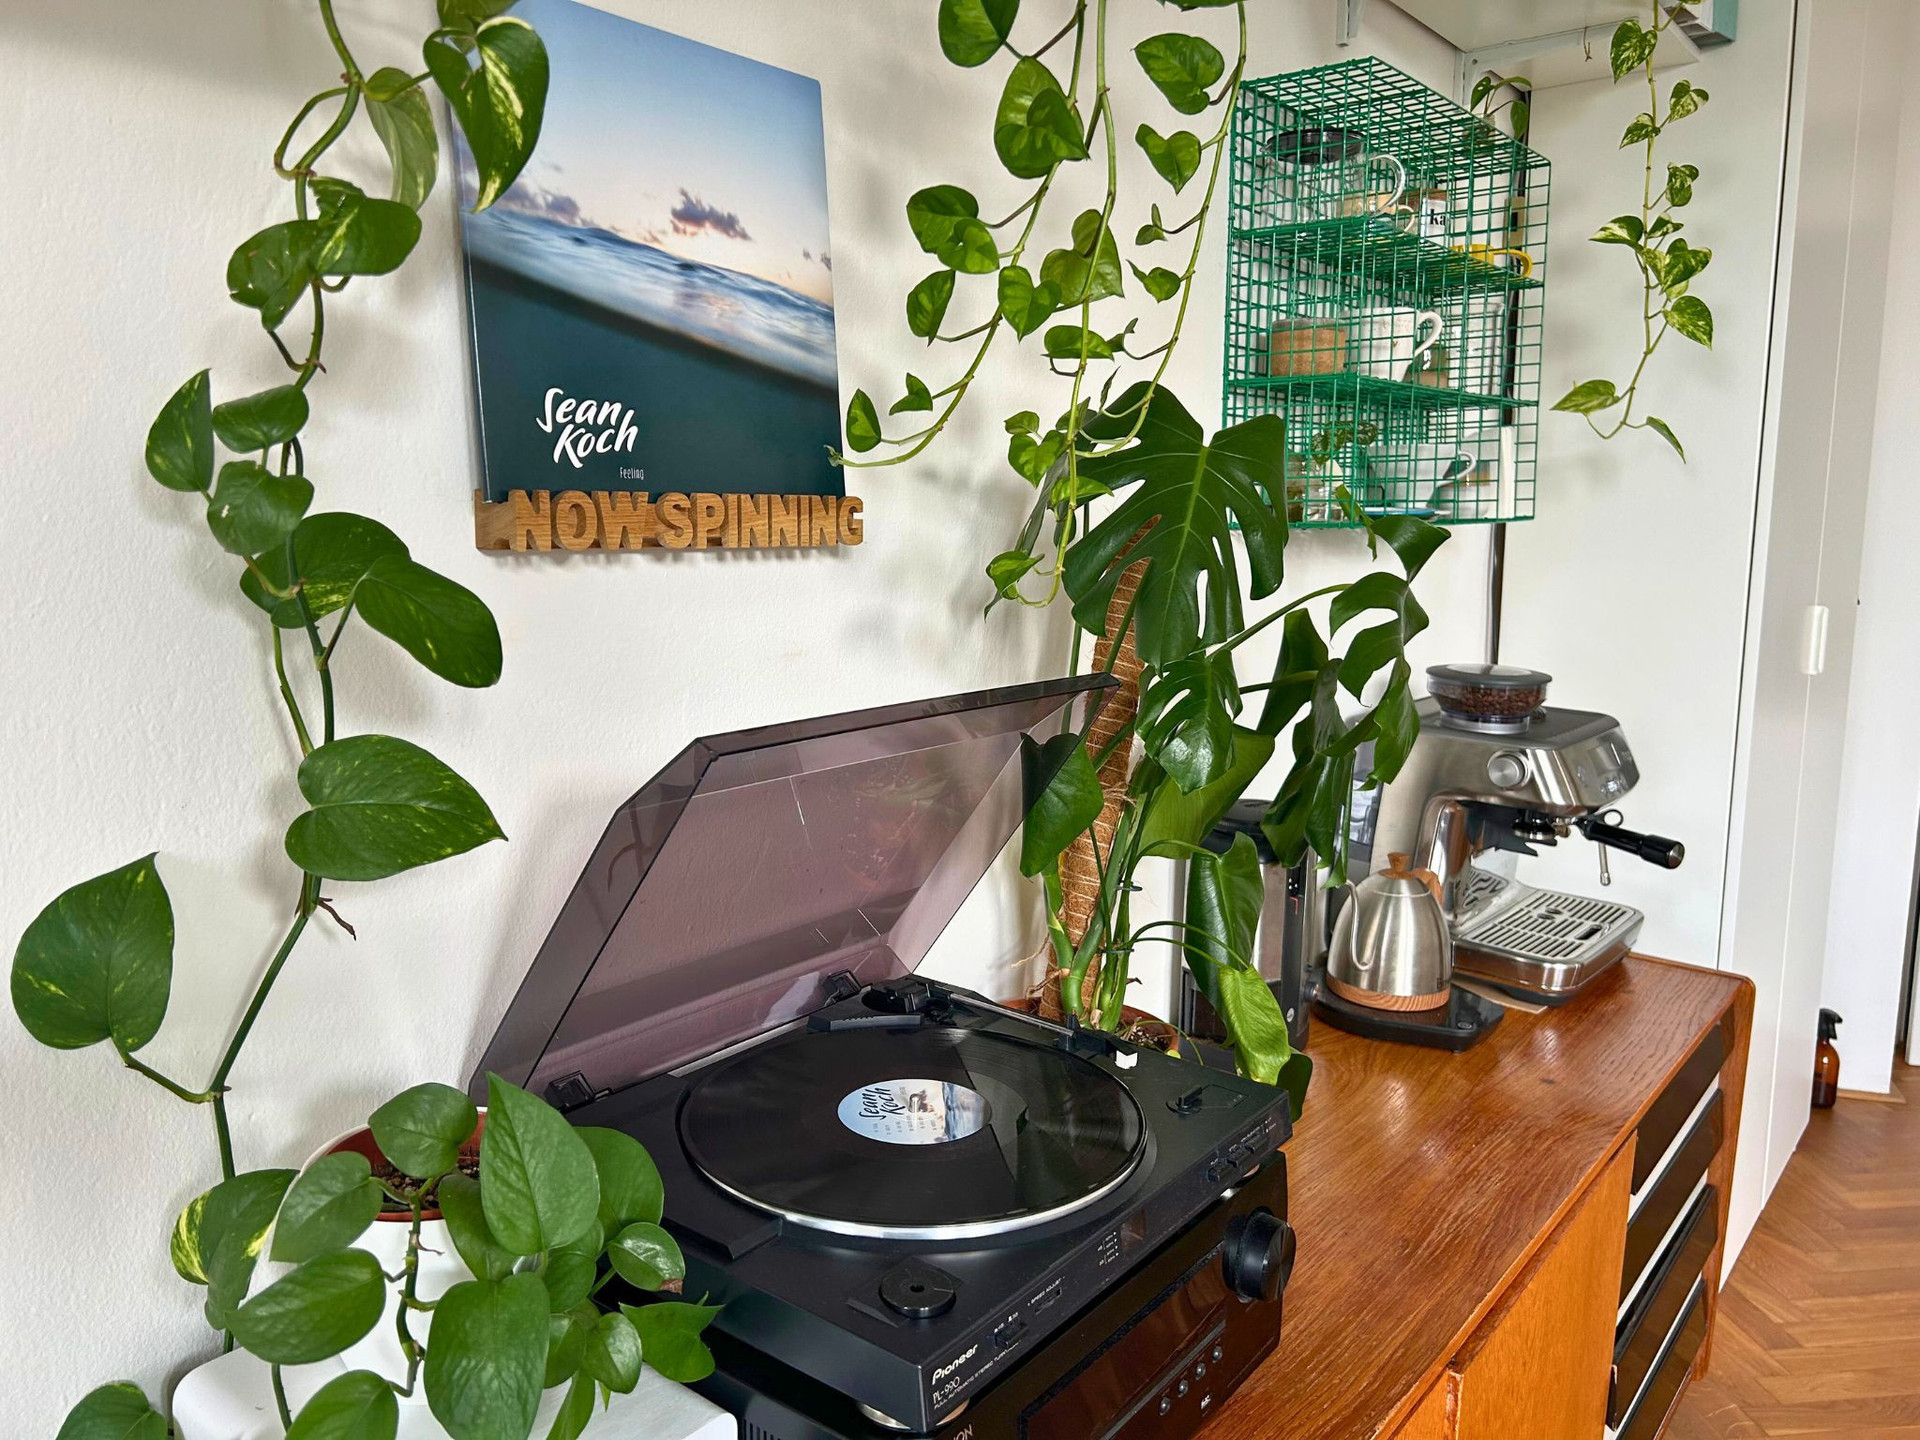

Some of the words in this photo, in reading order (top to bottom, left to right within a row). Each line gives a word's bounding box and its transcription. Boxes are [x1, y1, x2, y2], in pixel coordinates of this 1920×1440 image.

[536, 387, 622, 433] Sean
[553, 409, 639, 469] Koch
[620, 467, 644, 481] Feeling
[508, 489, 649, 552] NOW
[654, 491, 864, 549] SPINNING
[858, 1092, 887, 1120] Sean
[865, 1087, 906, 1115] Koch
[931, 1344, 978, 1385] Pioneer
[932, 1376, 960, 1404] PL-990
